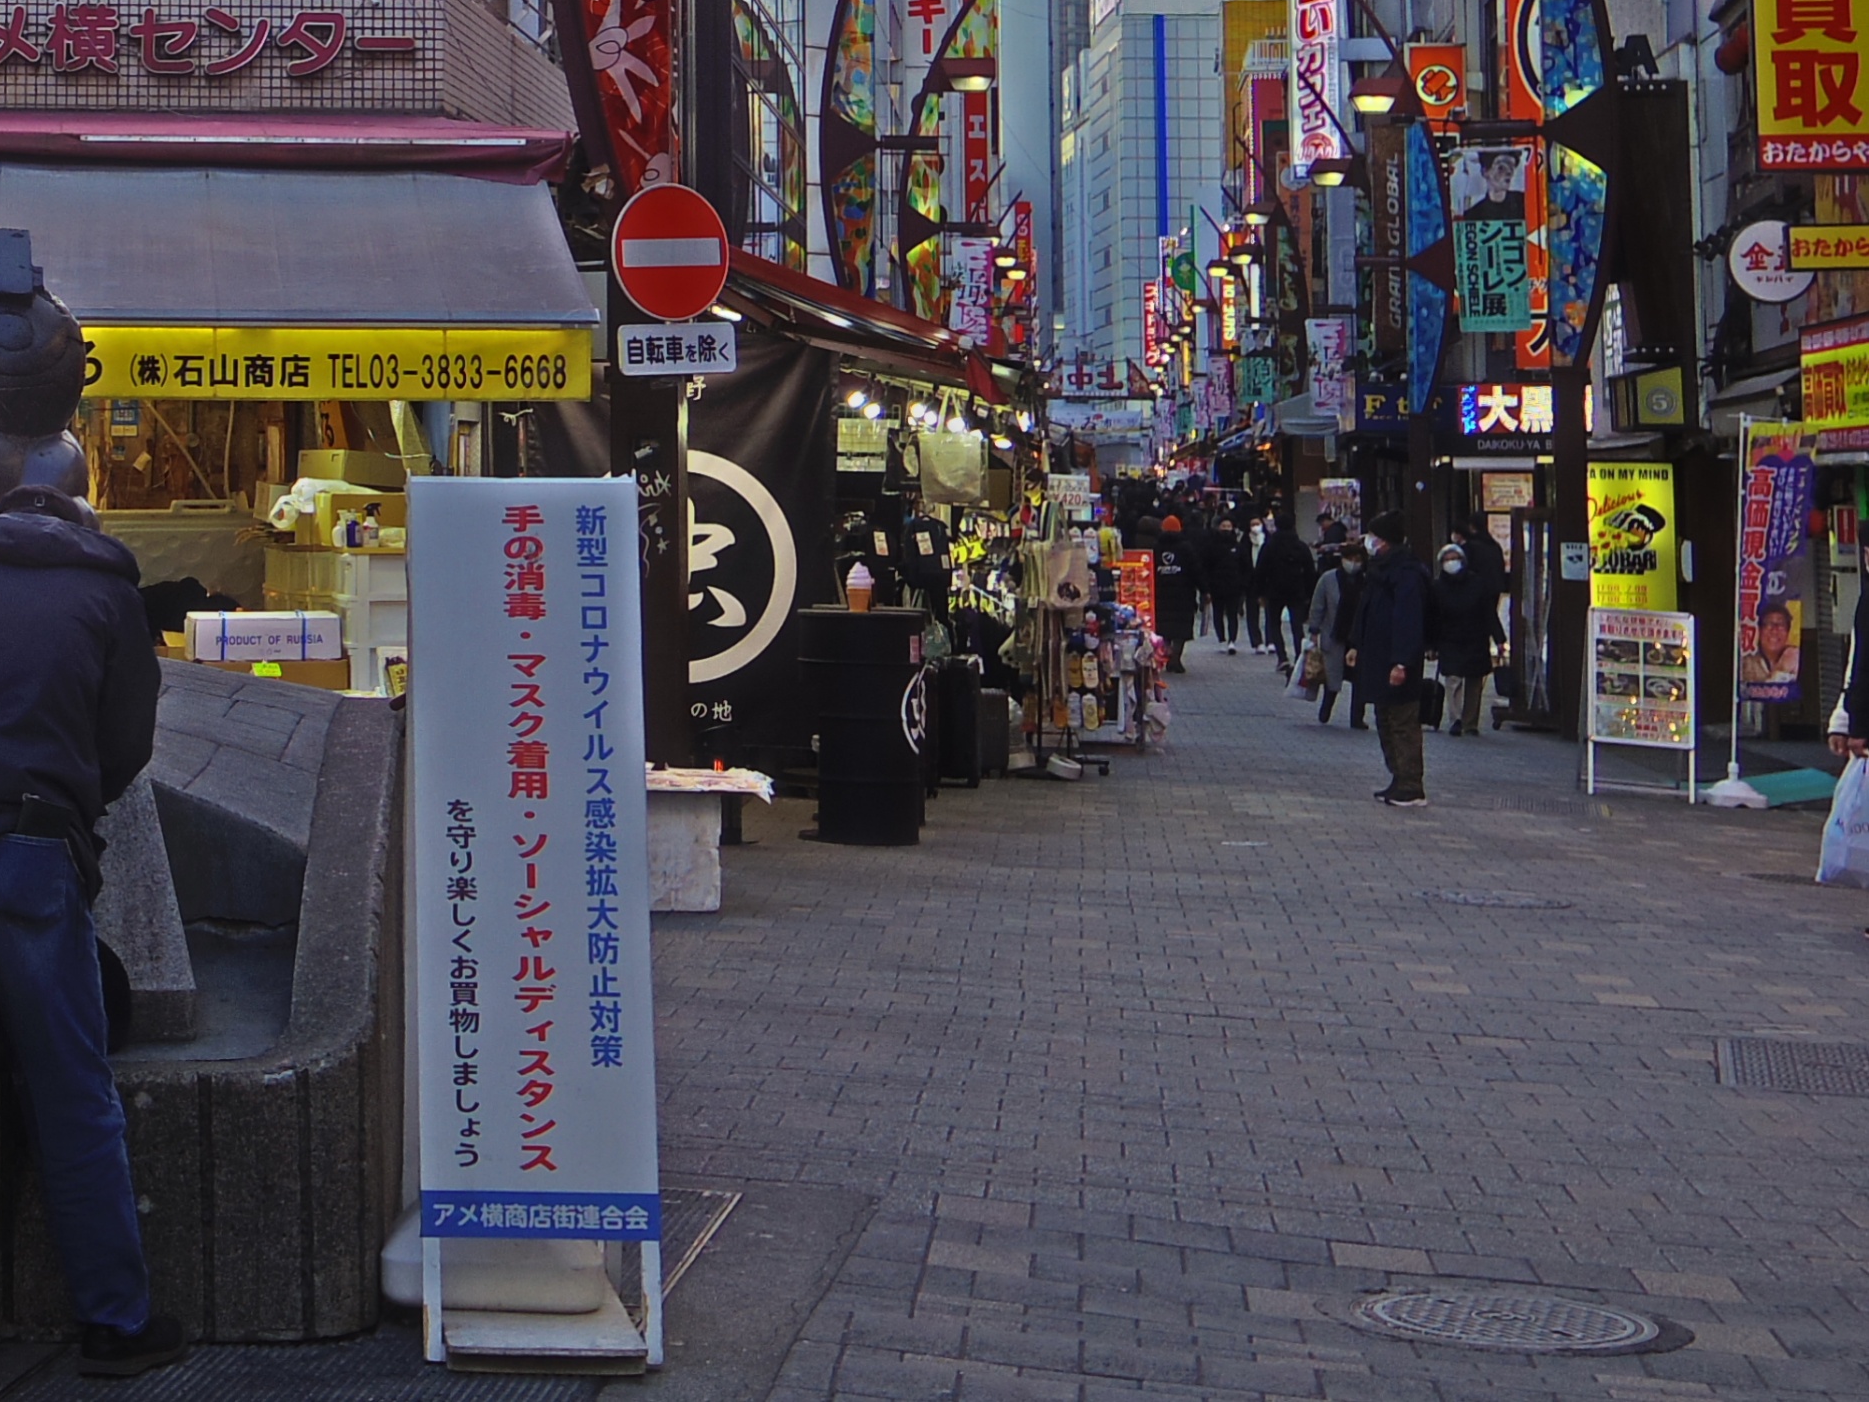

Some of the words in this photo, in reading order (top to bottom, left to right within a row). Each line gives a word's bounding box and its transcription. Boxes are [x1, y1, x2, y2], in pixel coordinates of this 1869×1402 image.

[1387, 153, 1402, 246] GLOBAL
[1465, 223, 1478, 261] EGON
[1467, 263, 1481, 317] SCHIELE
[1479, 222, 1507, 317] シーレ展
[130, 352, 311, 389] (株)石山商店
[329, 353, 568, 391] TEL03-3833-6668
[627, 335, 730, 366] 自転車を除く
[1477, 383, 1594, 434] 大黒
[1599, 468, 1615, 481] ON
[1618, 468, 1635, 481] MY
[1638, 468, 1669, 481] MIND
[215, 634, 263, 646] PRODUCT
[267, 634, 282, 646] OF
[574, 505, 623, 1069] 新型コロナウイルス感染拡大防止対策
[501, 504, 558, 1174] 手の消毒・マスク着用・ソーシャルディスタンス
[446, 798, 480, 1168] を守り楽しくお買物しましょう
[432, 1202, 650, 1231] アメ横商店街連合会
